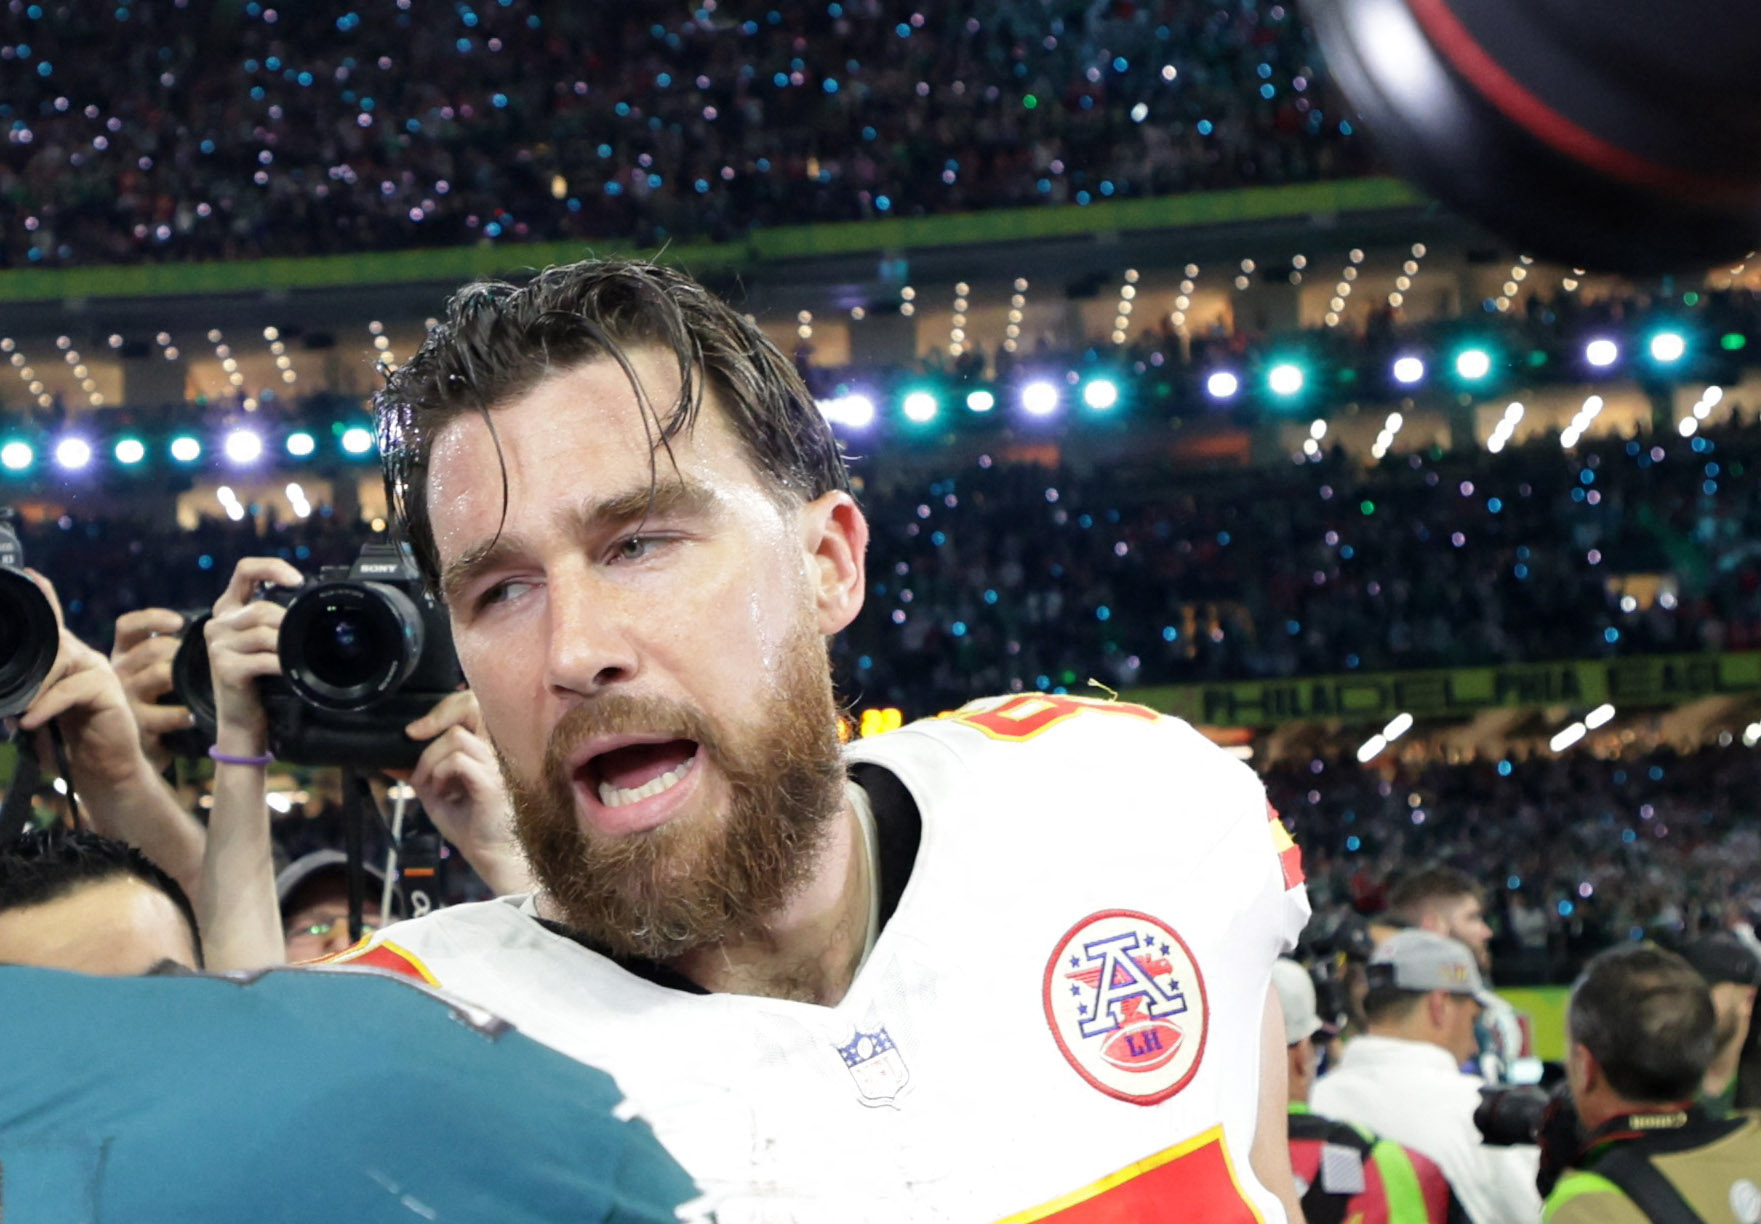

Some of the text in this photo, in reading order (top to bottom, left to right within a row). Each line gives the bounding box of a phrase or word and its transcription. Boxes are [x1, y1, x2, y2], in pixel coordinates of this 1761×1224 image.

[359, 564, 398, 573] SONY
[1078, 931, 1187, 1039] A
[1125, 1030, 1163, 1057] LH
